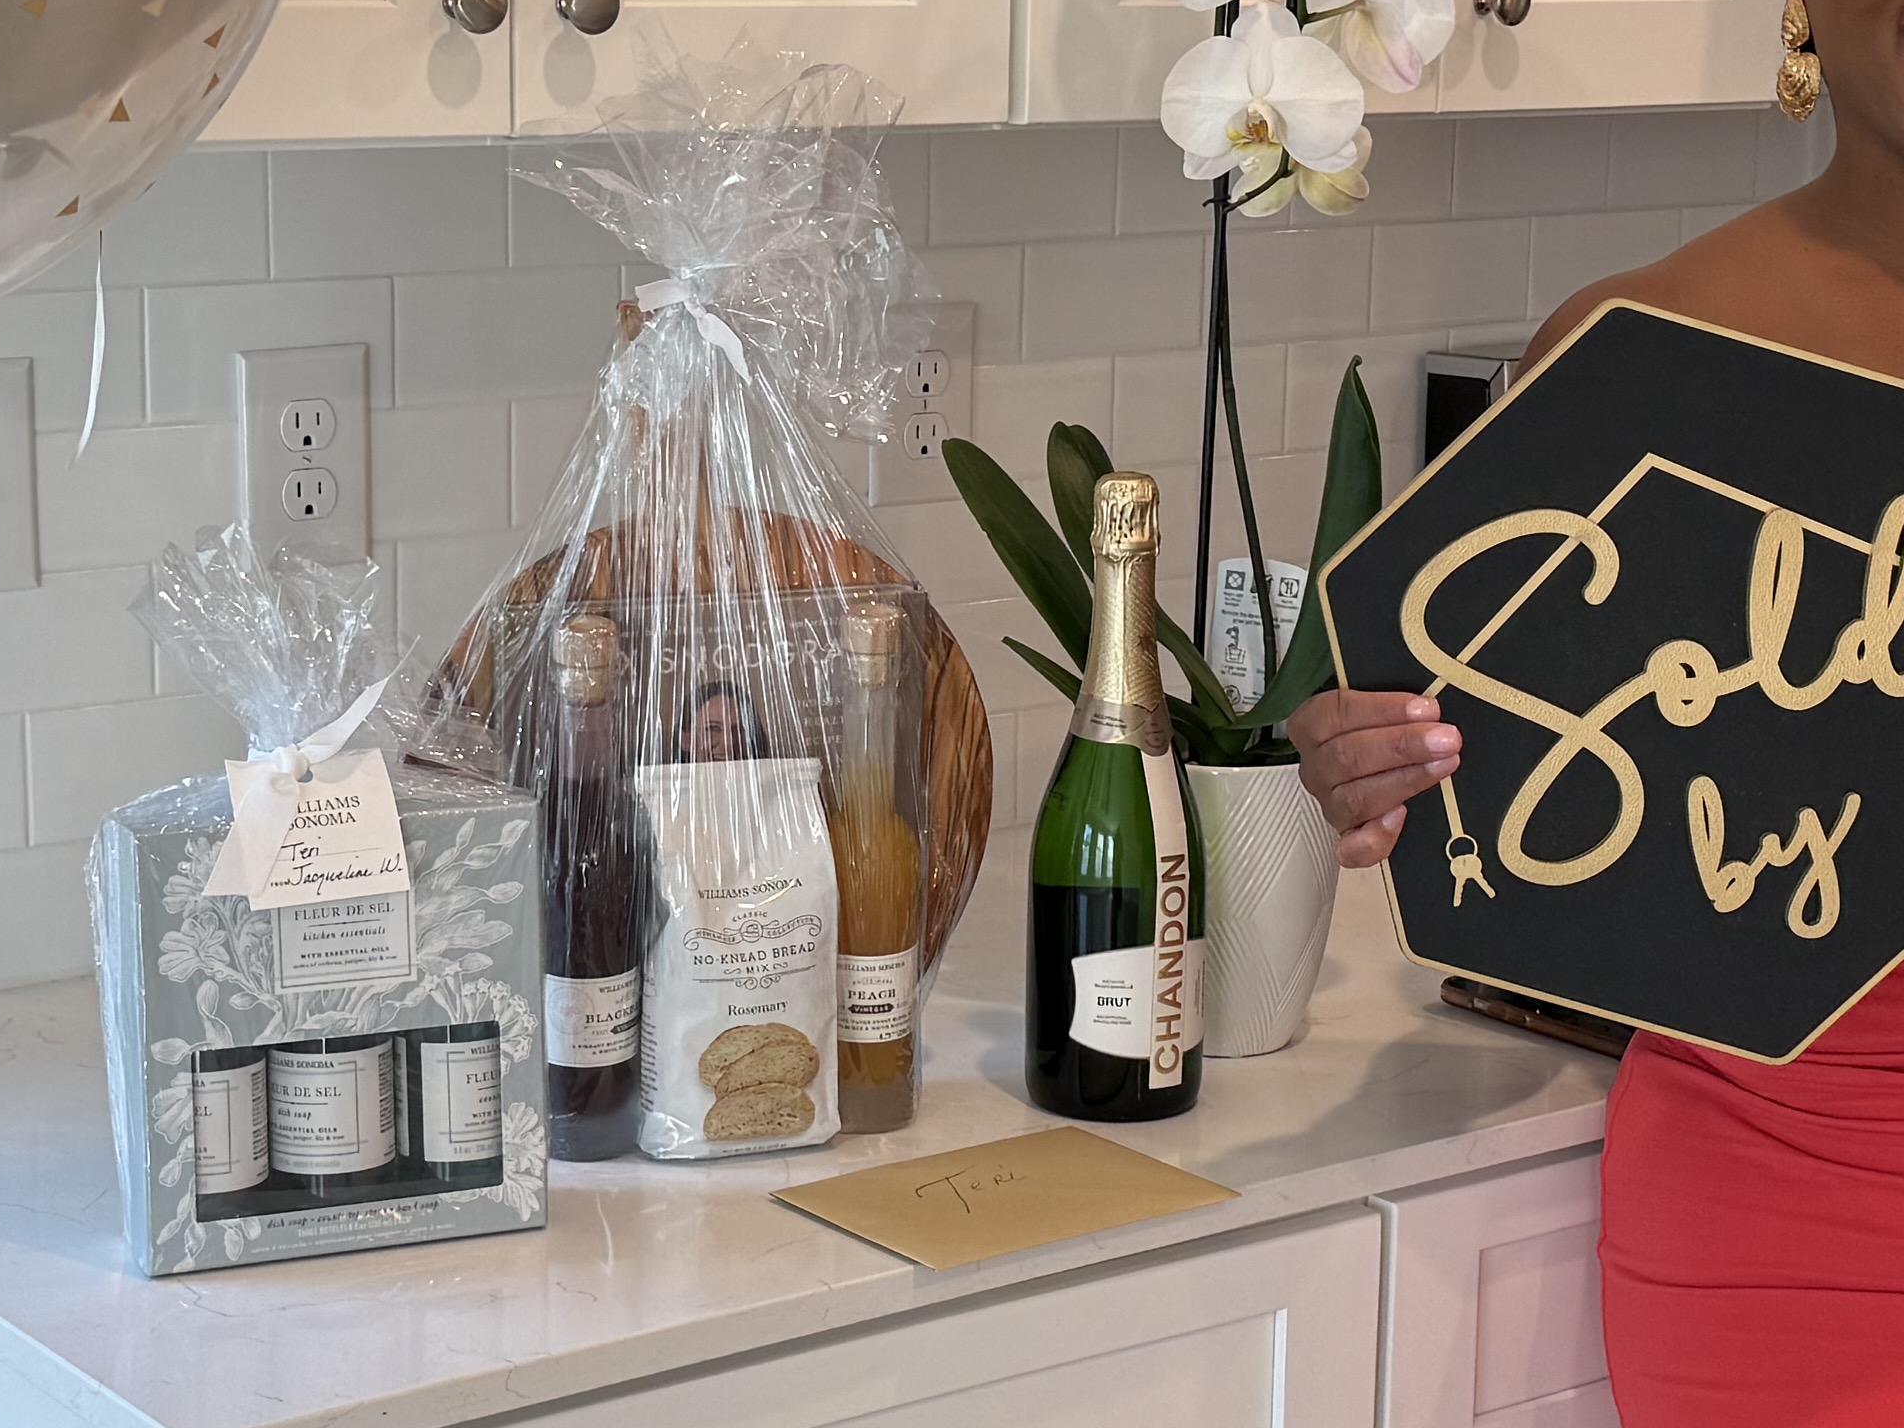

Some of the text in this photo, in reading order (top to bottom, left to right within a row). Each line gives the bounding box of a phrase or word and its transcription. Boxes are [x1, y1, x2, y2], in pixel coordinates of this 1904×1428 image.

[296, 795, 361, 814] LLIAMS
[1686, 774, 1861, 940] by
[292, 861, 373, 895] Jacqueline
[698, 887, 750, 901] WILLIAMS
[294, 901, 395, 921] FLEUR DE SEL
[732, 911, 769, 923] CLASSIC
[302, 925, 386, 941] kitchen essentials
[693, 942, 816, 966] NO-KNEAD BREAD
[747, 963, 770, 974] MIX
[1154, 853, 1186, 1074] CHANDON
[848, 988, 896, 1000] PEACH
[1097, 996, 1132, 1008] BRUT
[728, 1001, 788, 1017] Rosemary
[294, 1086, 311, 1098] DE
[315, 1086, 342, 1098] SEL
